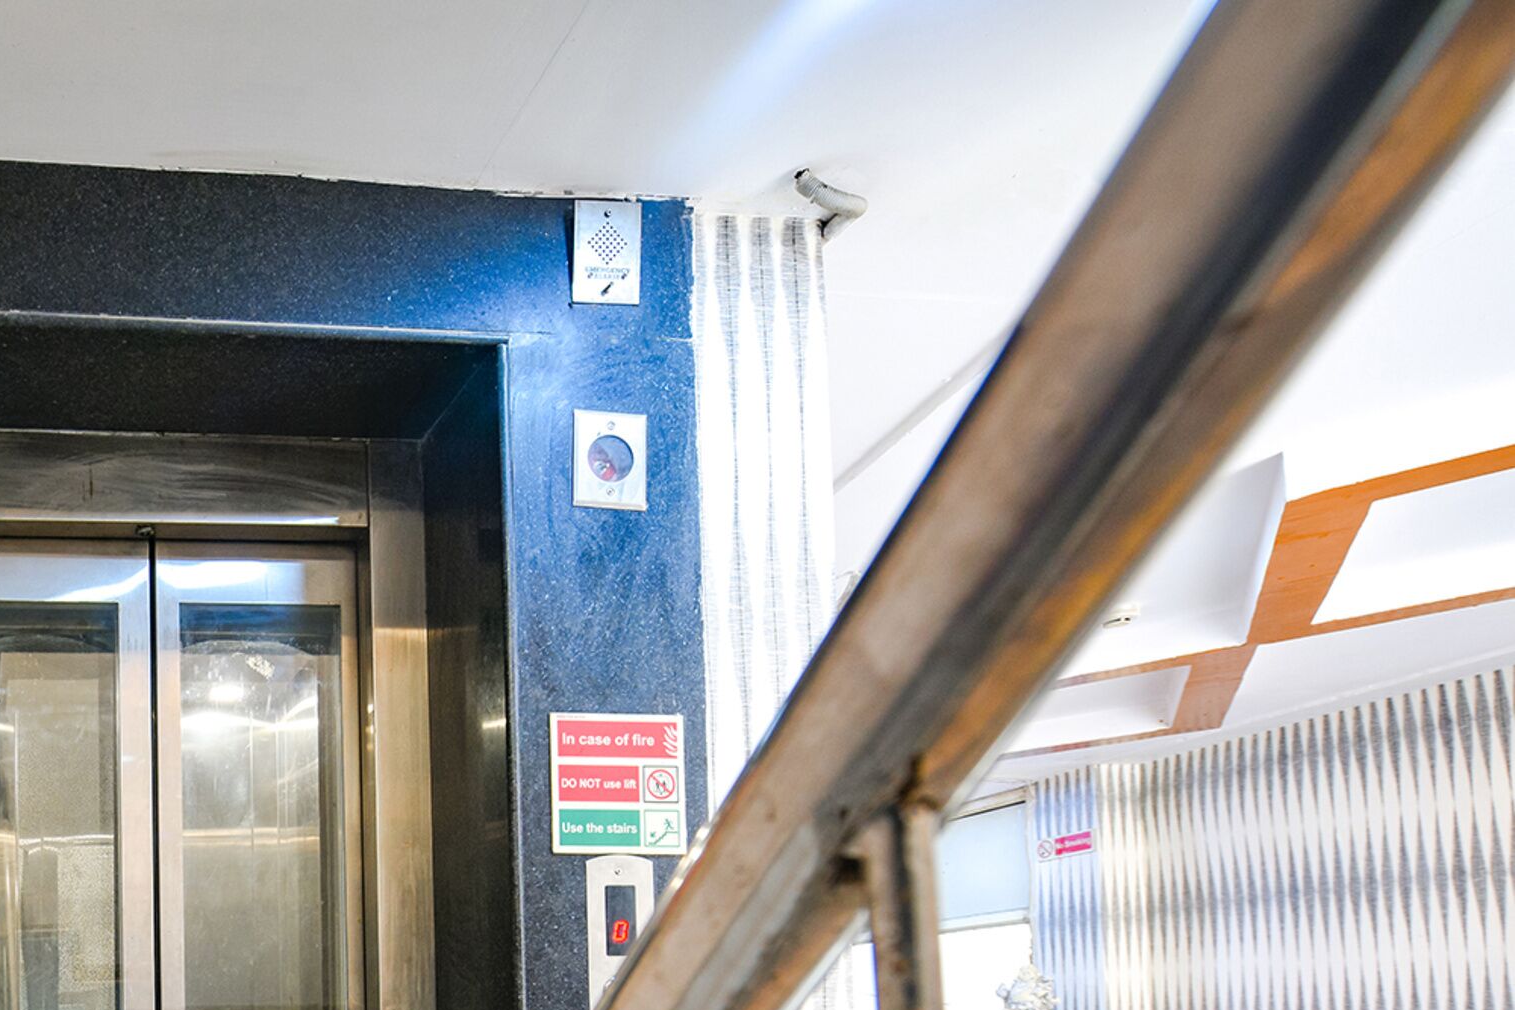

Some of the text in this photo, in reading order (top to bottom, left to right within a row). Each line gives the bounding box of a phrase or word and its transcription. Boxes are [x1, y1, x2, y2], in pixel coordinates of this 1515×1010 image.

[562, 733, 655, 747] In case of fire
[561, 778, 577, 789] DO
[579, 778, 601, 789] NOT
[603, 780, 621, 789] use
[562, 822, 637, 834] Use the stairs
[612, 919, 630, 944] 0
